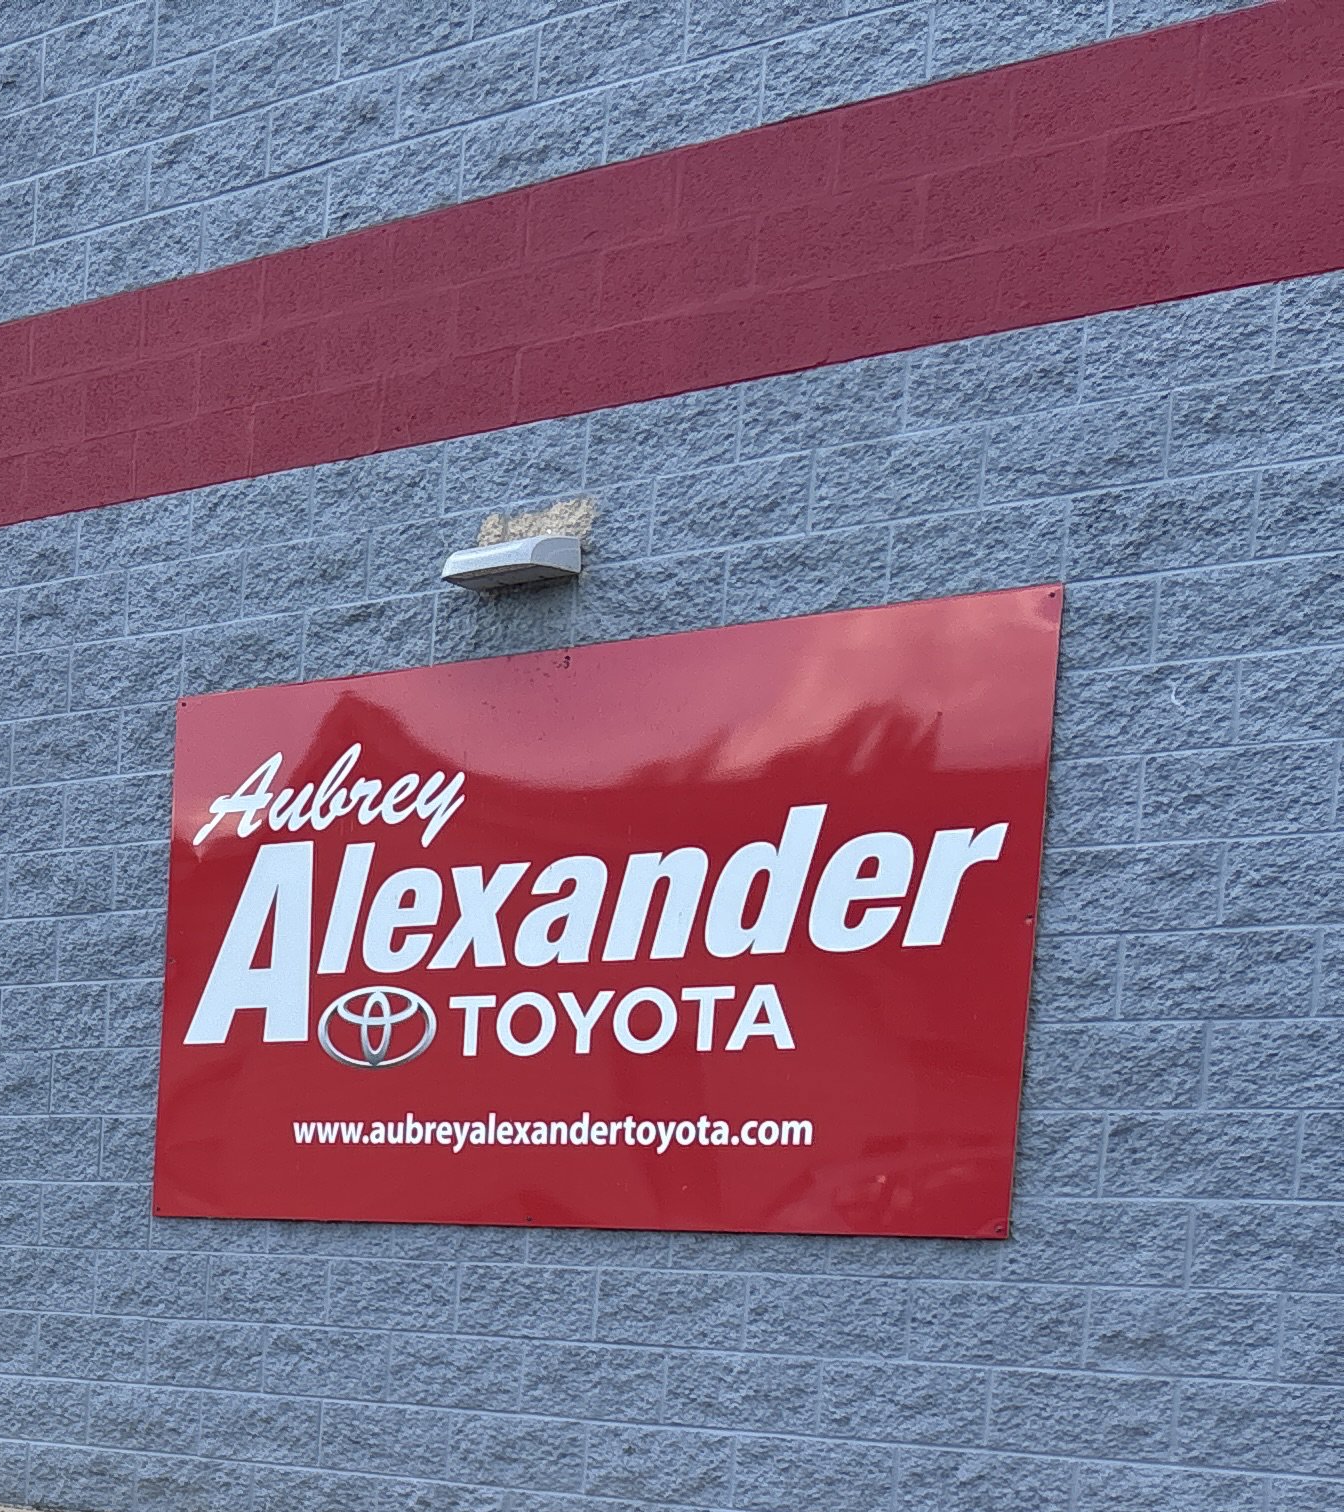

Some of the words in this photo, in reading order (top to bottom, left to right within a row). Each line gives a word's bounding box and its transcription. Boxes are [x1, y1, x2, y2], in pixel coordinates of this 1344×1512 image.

[193, 742, 466, 848] Aubrey
[183, 803, 1009, 1045] Alexander
[449, 984, 796, 1057] TOYOTA
[293, 1111, 813, 1155] www.aubreyalexandertoyota.com
